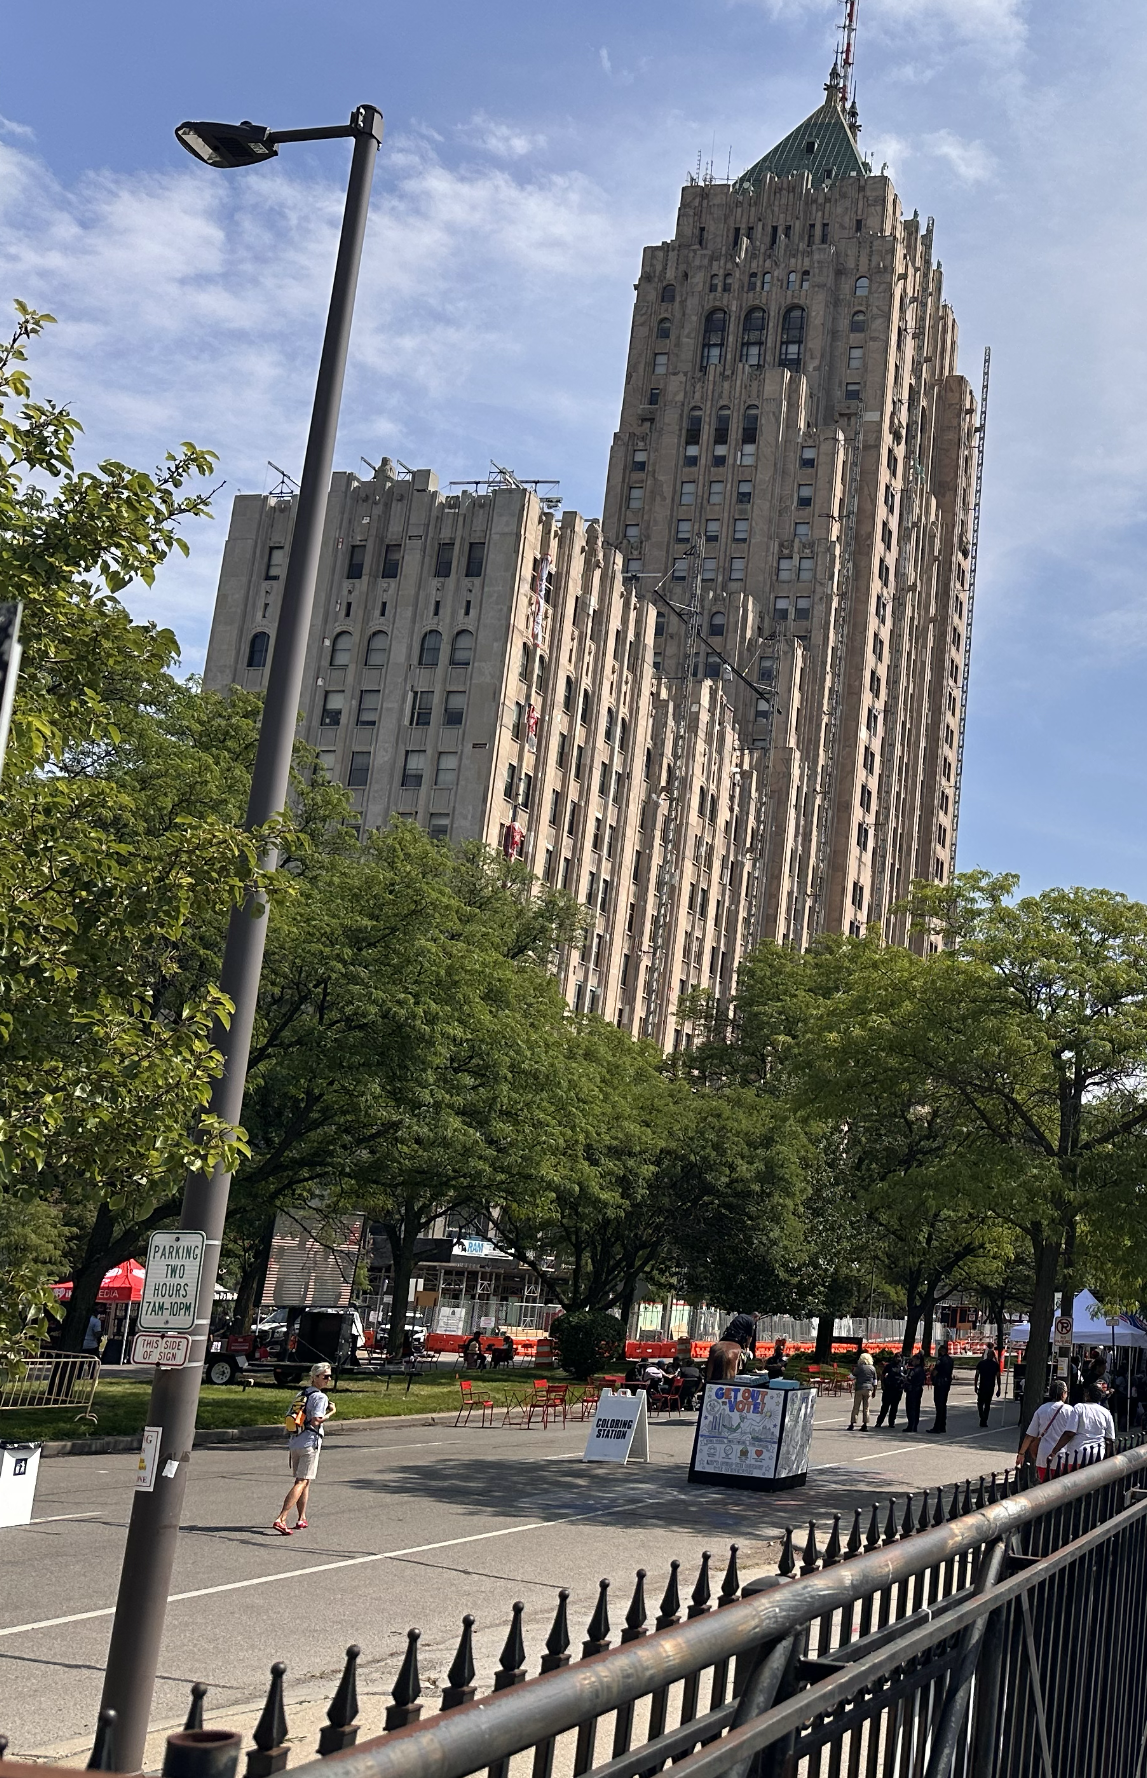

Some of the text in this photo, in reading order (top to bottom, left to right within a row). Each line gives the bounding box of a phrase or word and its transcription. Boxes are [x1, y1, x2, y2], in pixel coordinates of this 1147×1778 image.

[152, 1245, 200, 1260] PARKING
[165, 1264, 186, 1279] TWO
[153, 1283, 189, 1298] HOURS
[145, 1301, 192, 1317] 7AM-10PM
[142, 1338, 182, 1350] THIS SIDE
[143, 1350, 176, 1361] OF SIGN
[715, 1386, 768, 1403] GET OUT
[727, 1400, 767, 1415] VOTE!
[595, 1418, 633, 1430] COLORING
[595, 1429, 628, 1440] STATION
